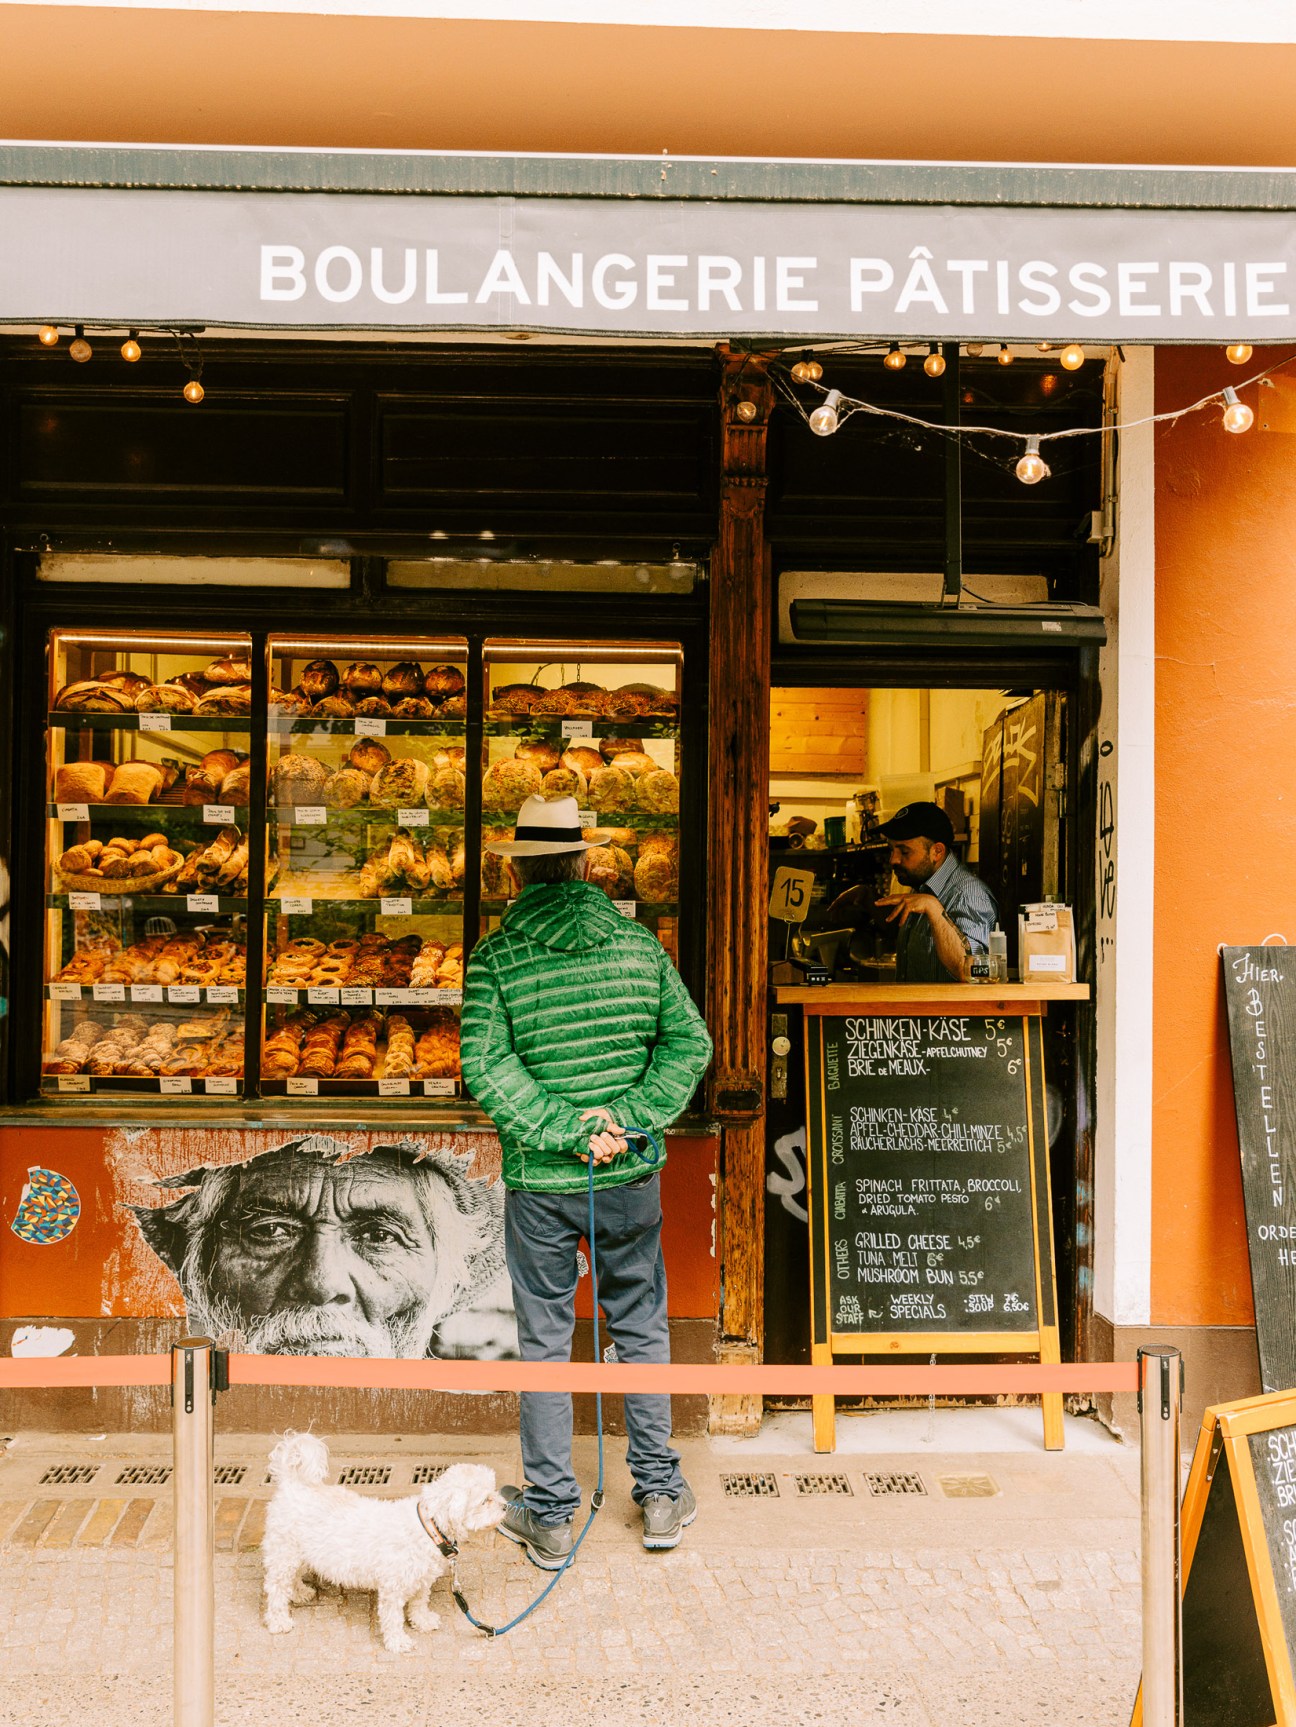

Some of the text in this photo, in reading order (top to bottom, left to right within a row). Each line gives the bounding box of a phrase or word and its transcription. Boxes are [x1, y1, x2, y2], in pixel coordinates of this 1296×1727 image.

[260, 245, 1290, 317] BOULANGERIE PÂTISSERIE
[781, 878, 804, 907] 15
[827, 1042, 840, 1090] BAGUETTE
[847, 1059, 876, 1077] BRIE
[832, 1114, 844, 1164] CROISSANT
[856, 1179, 903, 1193] SPINACH
[859, 1193, 890, 1204] DRIED
[896, 1194, 936, 1204] TOMATO
[940, 1193, 969, 1204] PESTO
[855, 1232, 901, 1249] GRILLED
[908, 1234, 952, 1250] CHEESE
[834, 1239, 850, 1279] OTHERS
[857, 1250, 886, 1266] TUNA
[893, 1251, 918, 1267] MELT
[857, 1267, 919, 1284] MUSHROOM
[926, 1268, 954, 1284] BUN
[839, 1295, 859, 1305] ASK
[890, 1293, 934, 1304] WEEKLY
[968, 1302, 994, 1312] SOUP
[839, 1304, 861, 1314] OUR
[890, 1303, 946, 1319] SPECIALS
[836, 1312, 864, 1324] STAFF
